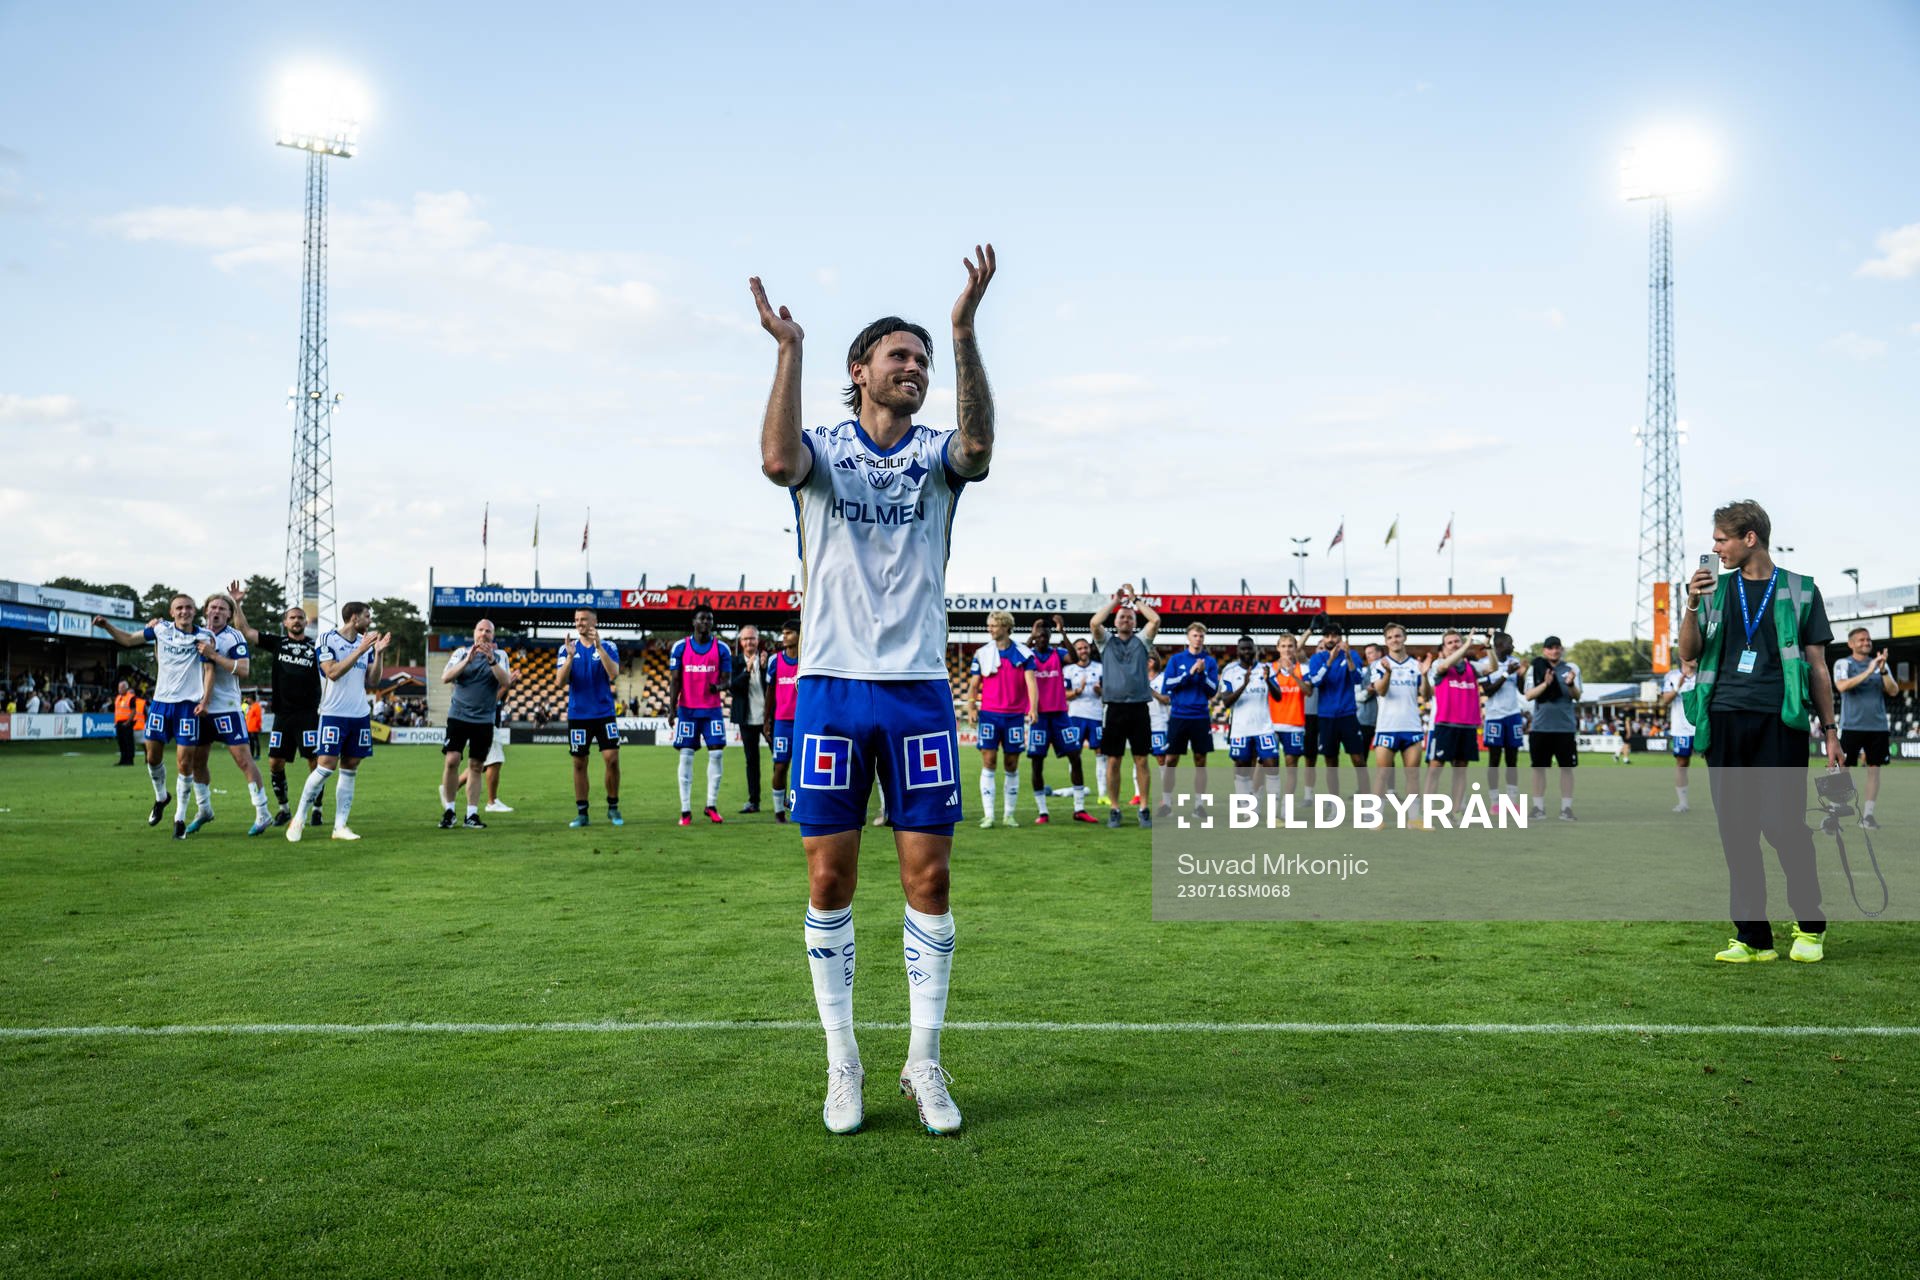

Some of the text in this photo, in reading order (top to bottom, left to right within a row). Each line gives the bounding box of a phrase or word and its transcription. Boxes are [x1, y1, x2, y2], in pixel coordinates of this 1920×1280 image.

[832, 498, 925, 525] HOLMEN
[465, 589, 594, 606] Ronnebybrunn.se
[944, 594, 1068, 611] RÖRMONTAGE
[278, 653, 313, 667] HOLMEN
[685, 664, 715, 672] stadium
